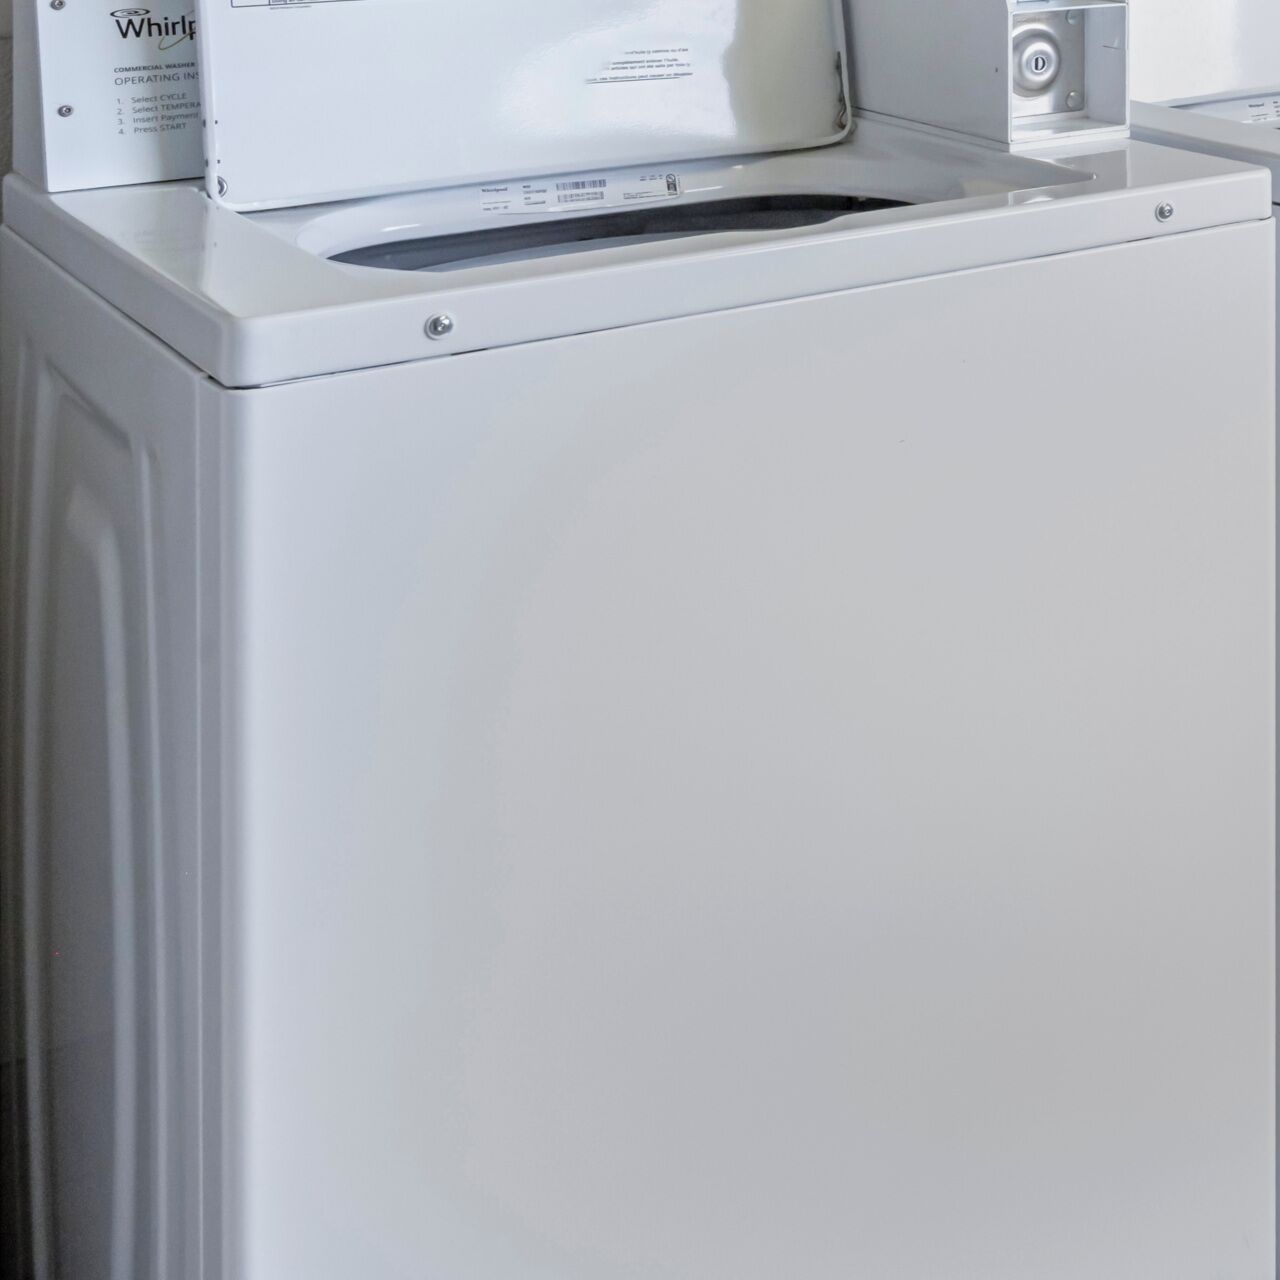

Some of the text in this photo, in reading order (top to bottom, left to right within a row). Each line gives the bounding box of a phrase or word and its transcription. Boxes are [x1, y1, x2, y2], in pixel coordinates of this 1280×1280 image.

[114, 64, 163, 73] COMMERCIAL
[114, 73, 180, 85] OPERATING
[160, 93, 187, 101] CYCLE
[132, 106, 158, 114] Select
[133, 116, 158, 124] Insert
[134, 123, 187, 134] Press START
